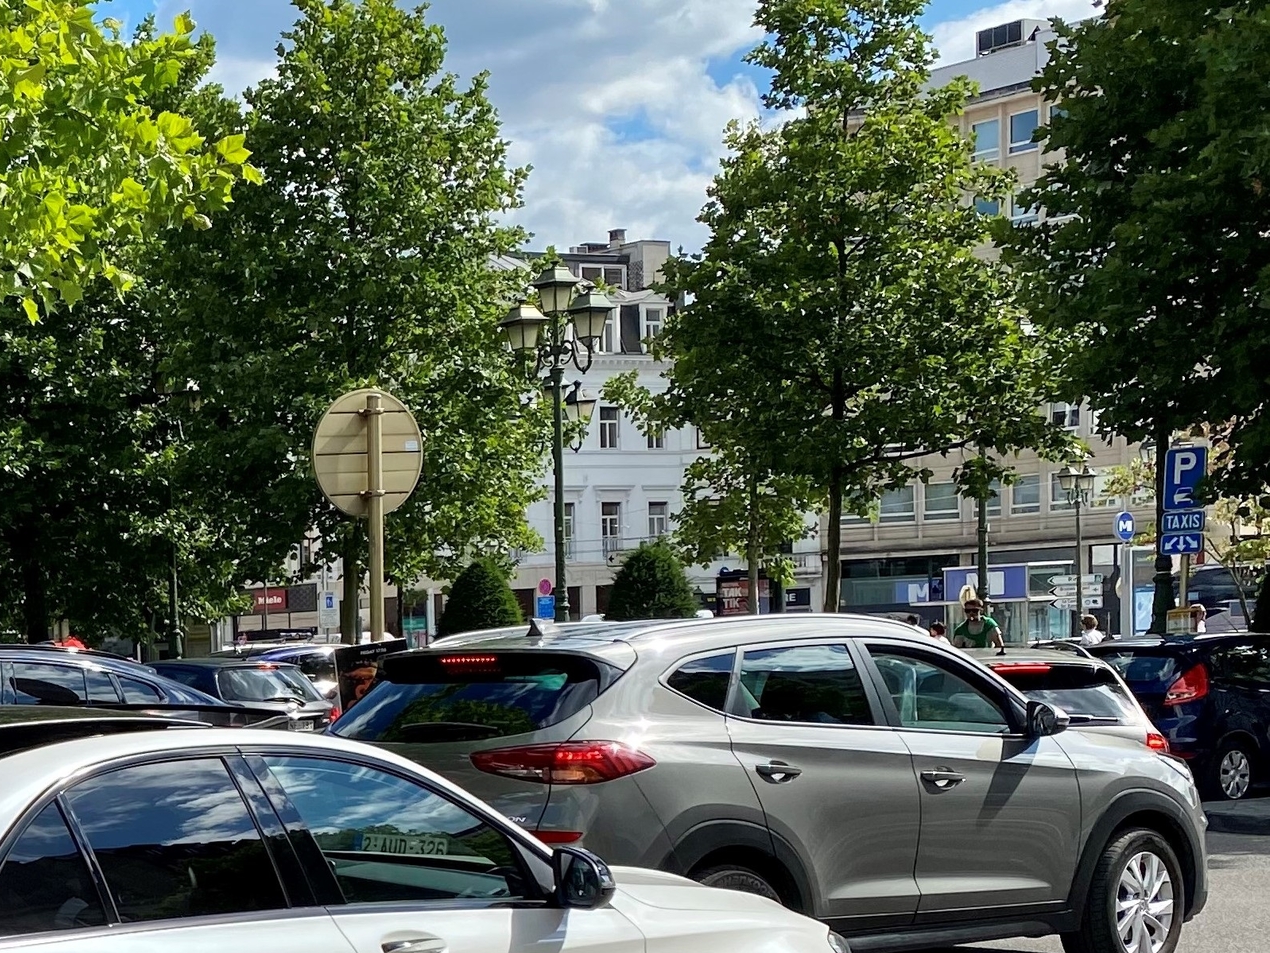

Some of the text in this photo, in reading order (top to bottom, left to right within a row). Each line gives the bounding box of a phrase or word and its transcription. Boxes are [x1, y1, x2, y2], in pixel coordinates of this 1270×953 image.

[1173, 451, 1197, 485] P
[1118, 520, 1133, 532] M
[1165, 514, 1200, 530] TAXIS
[722, 587, 742, 598] TAK
[908, 583, 929, 603] M
[257, 595, 282, 605] Miele
[722, 598, 741, 609] TIK
